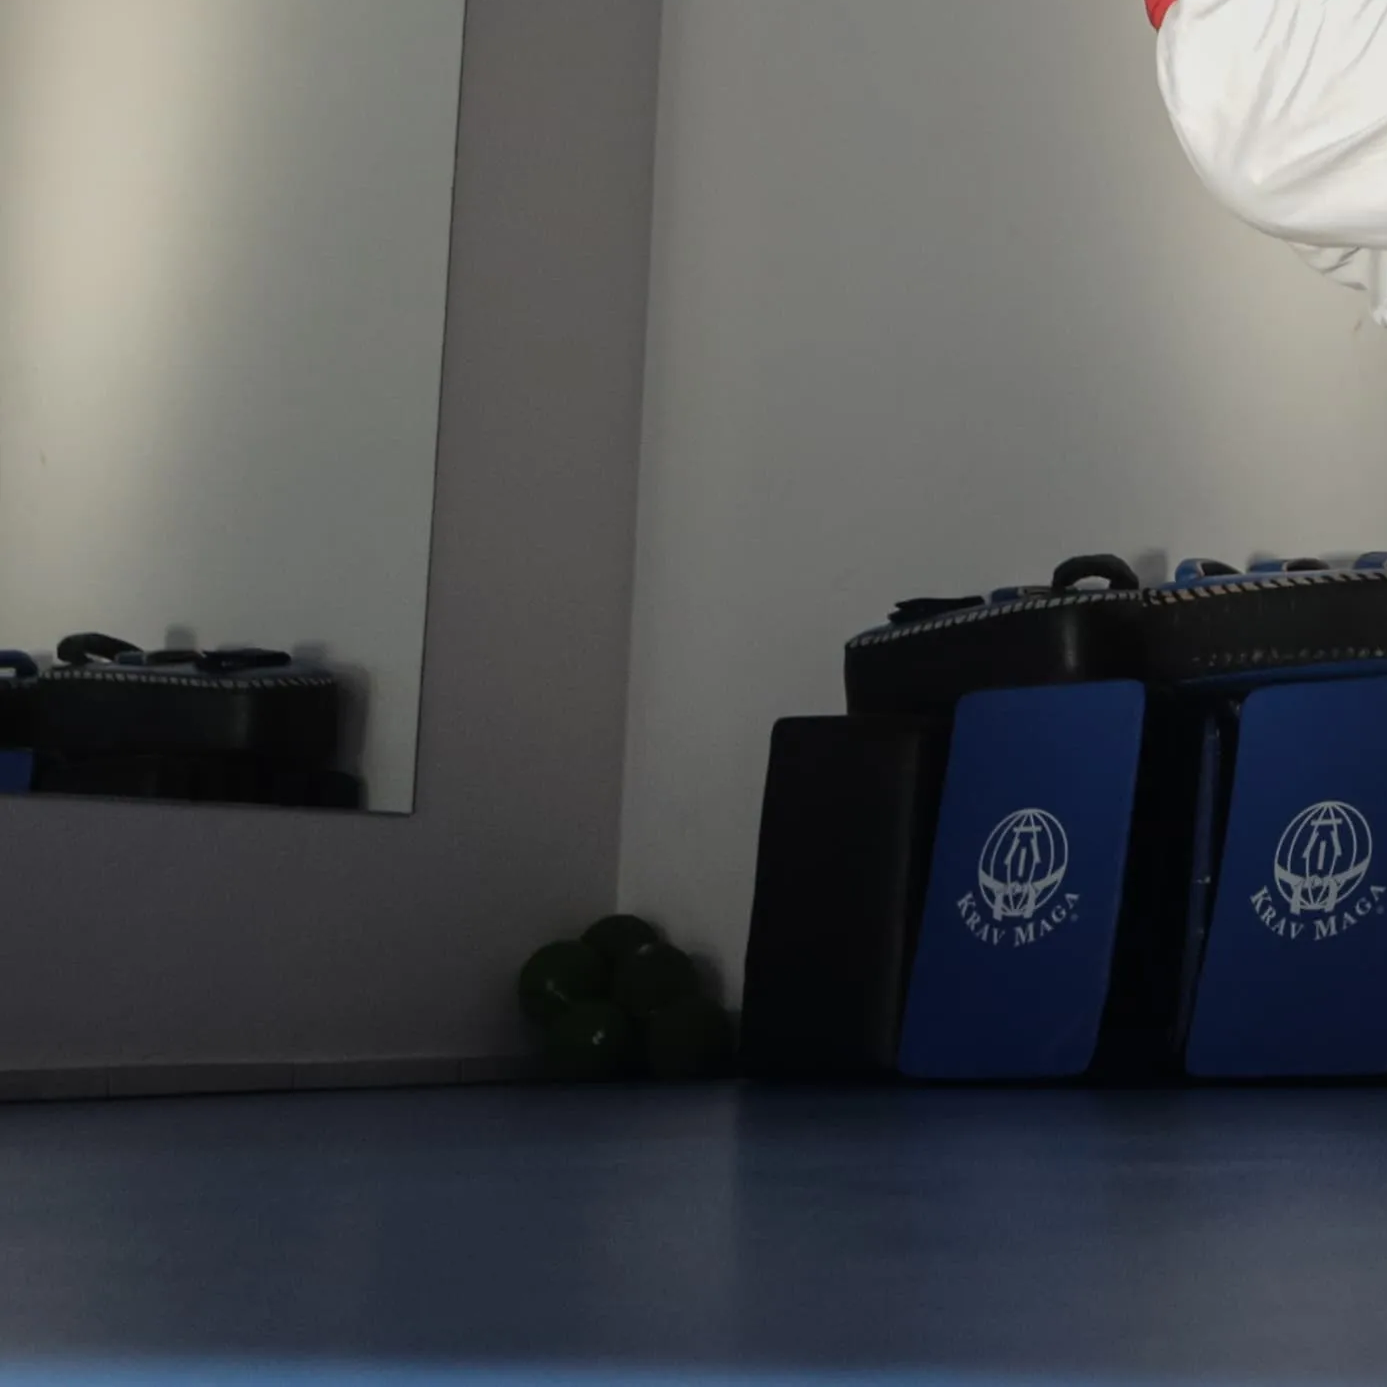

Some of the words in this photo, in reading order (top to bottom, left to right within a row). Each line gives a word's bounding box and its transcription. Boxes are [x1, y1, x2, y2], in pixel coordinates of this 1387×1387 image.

[956, 890, 1006, 946] KRAV
[1013, 892, 1080, 948] MAGA
[1249, 885, 1305, 940] KRAV
[1313, 884, 1387, 941] MAGA
